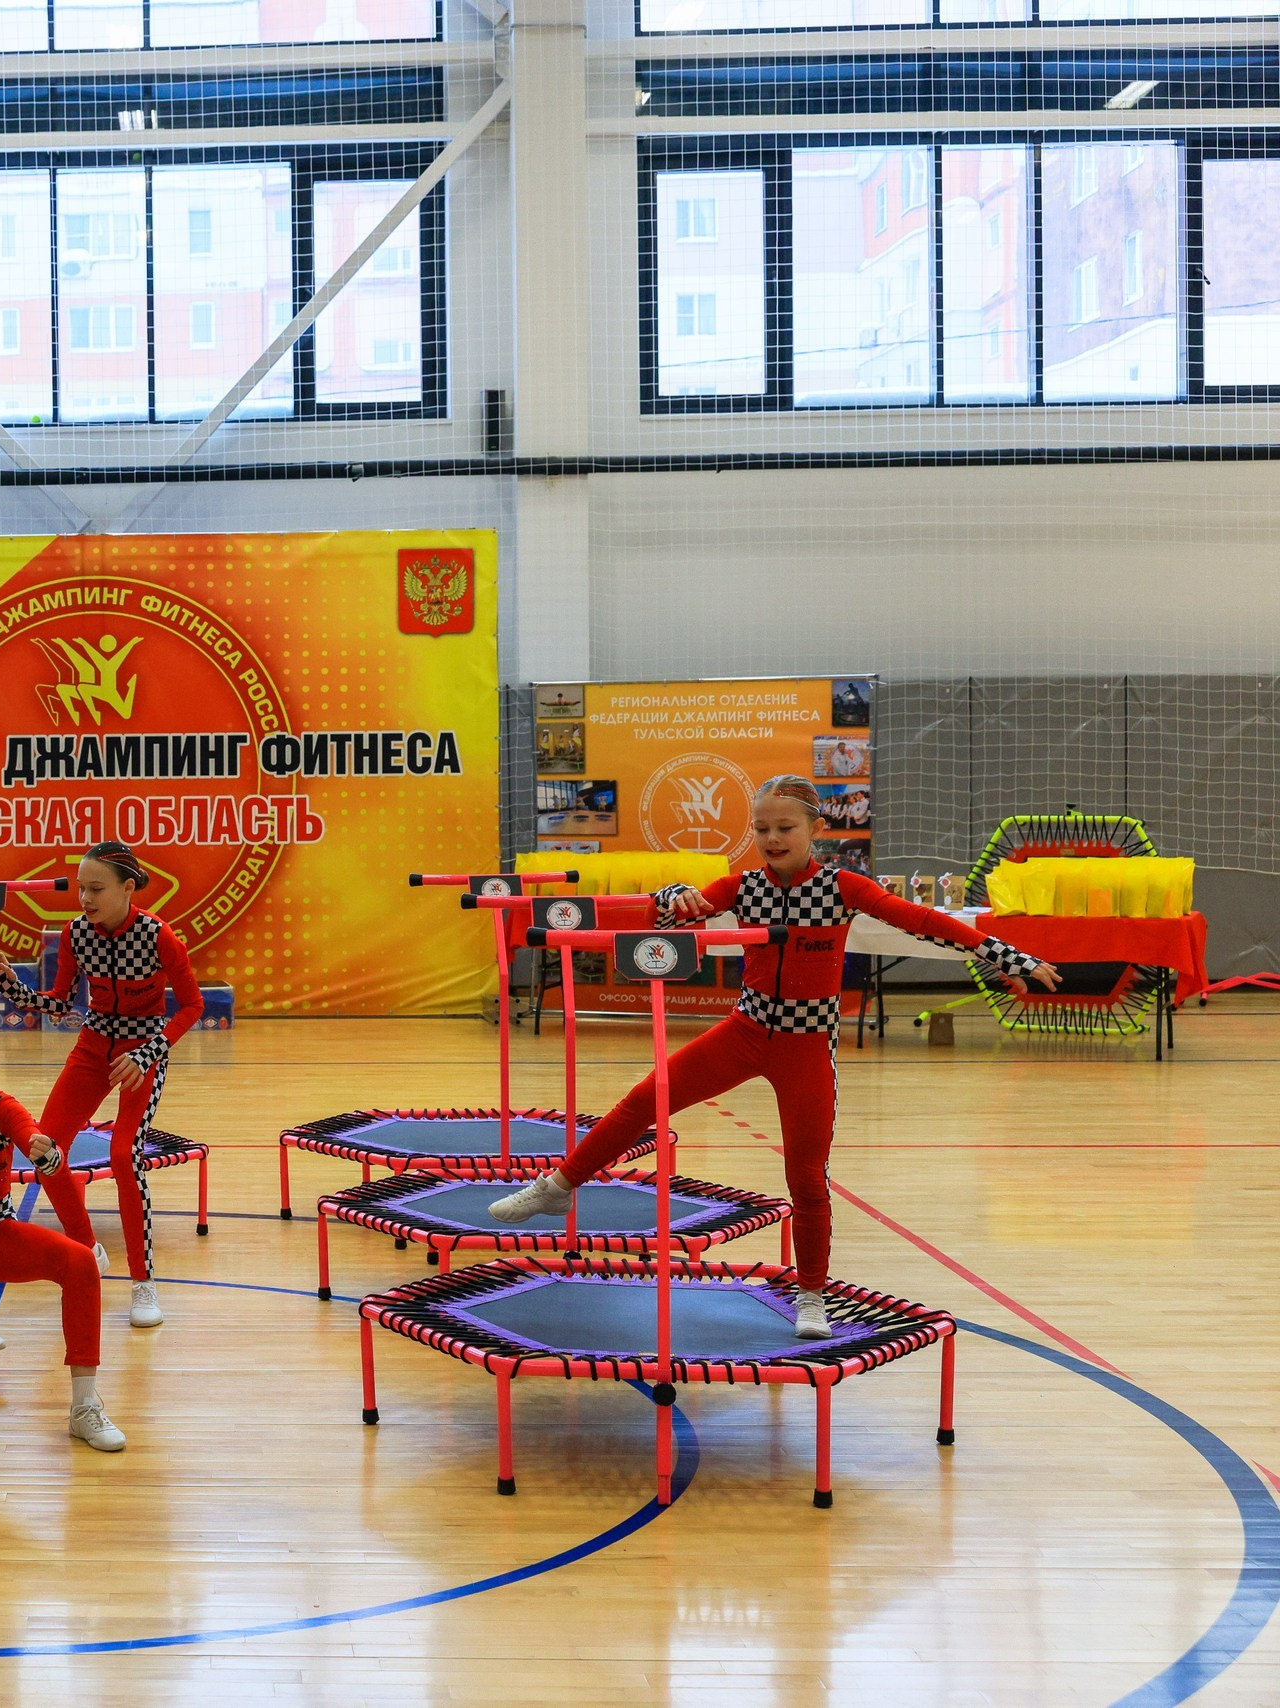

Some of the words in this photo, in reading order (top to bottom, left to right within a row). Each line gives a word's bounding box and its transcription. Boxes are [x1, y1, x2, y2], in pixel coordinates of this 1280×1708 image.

[140, 593, 244, 670] ФИТНЕСА
[238, 668, 281, 737] РОСС
[611, 695, 715, 708] РЕГИОНАЛЬНОЕ
[719, 693, 798, 707] ОТДЕЛЕНИЕ
[589, 712, 669, 725] ФЕДЕРАЦИИ
[673, 710, 753, 724] ДЖАМПИНГ
[756, 710, 820, 722] ФИТНЕСА
[634, 726, 704, 739] ТУЛЬСКОЙ
[708, 727, 773, 739] ОБЛАСТИ
[3, 732, 249, 787] ДЖАМПИНГ
[260, 730, 462, 778] ФИТНЕСА
[116, 794, 324, 846] ОБЛАСТЬ
[699, 997, 738, 1006] ДЖАМП
